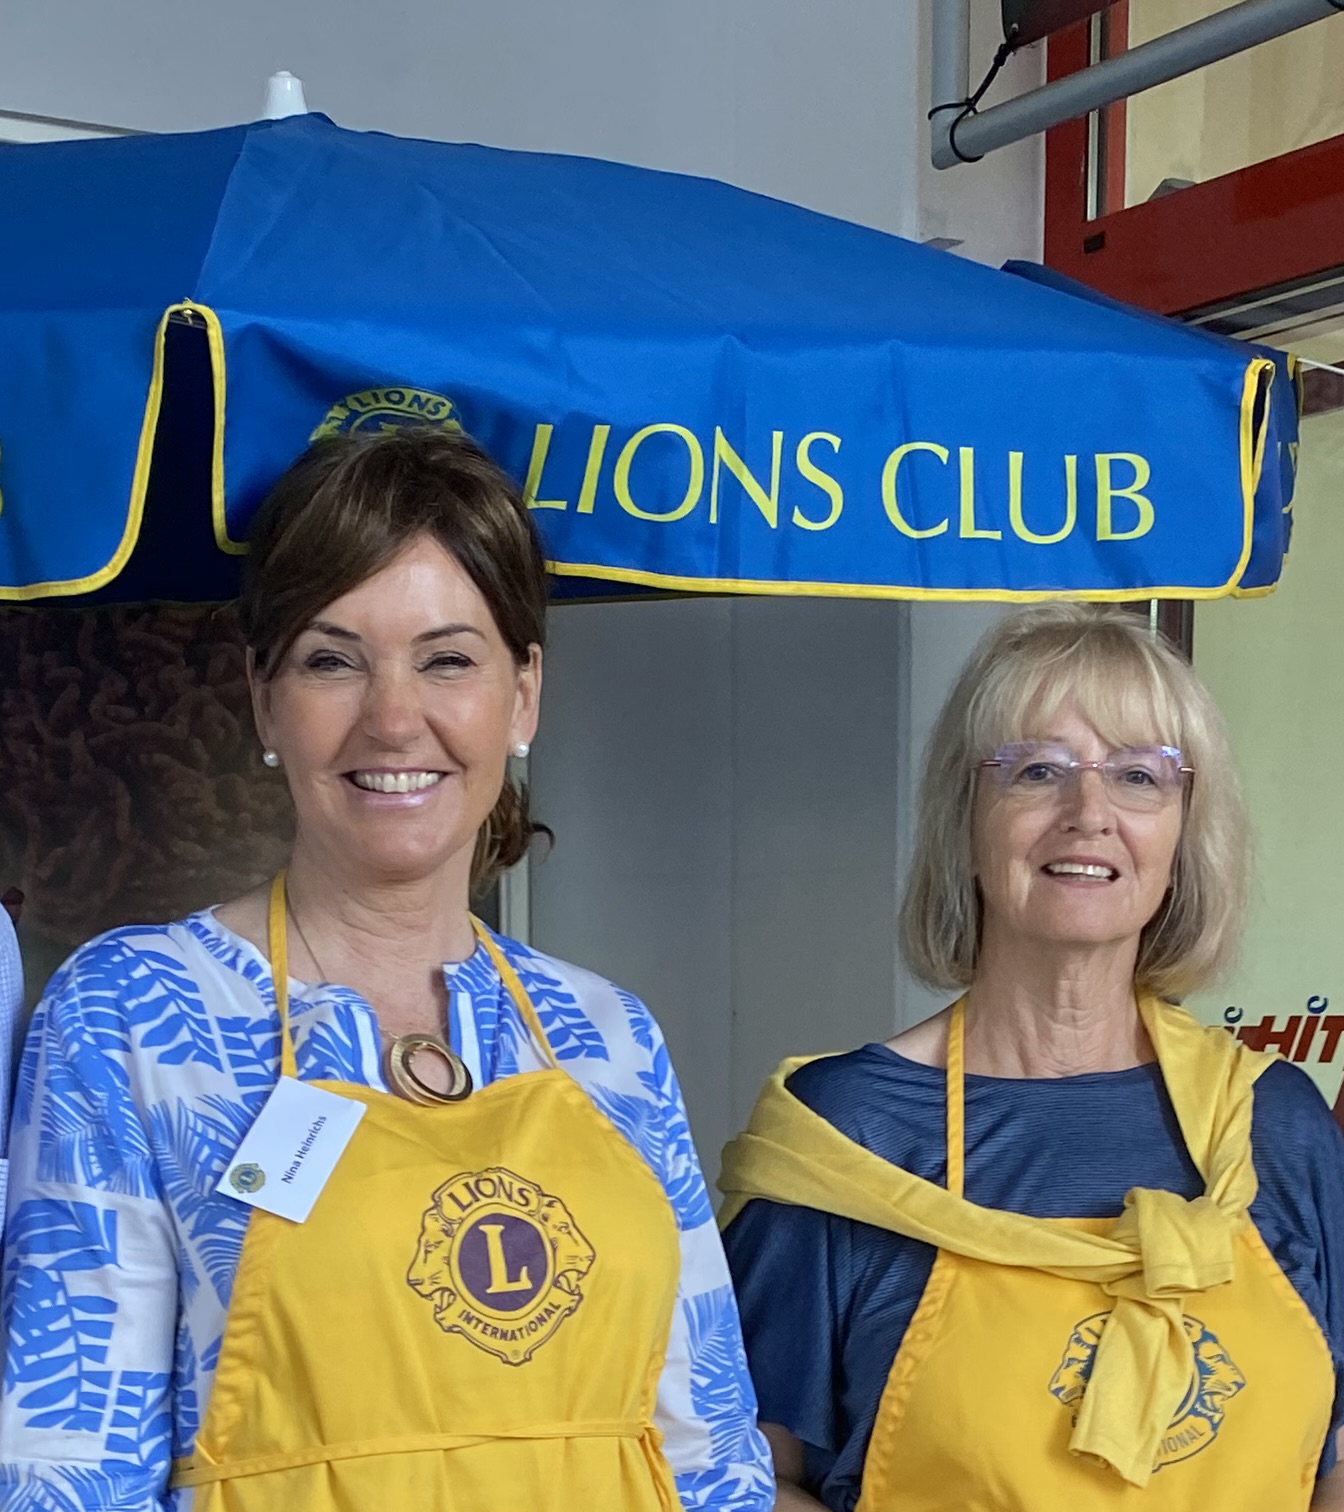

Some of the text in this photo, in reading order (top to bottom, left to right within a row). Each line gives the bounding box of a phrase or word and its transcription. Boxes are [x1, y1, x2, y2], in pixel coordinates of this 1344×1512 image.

[351, 389, 447, 417] LIONS
[524, 423, 844, 531] LIONS
[881, 441, 1156, 544] CLUB
[281, 1115, 327, 1185] Nina Heinrichs
[447, 1176, 532, 1212] LIONS
[478, 1224, 533, 1293] L
[457, 1302, 561, 1342] INTERNATIONAL
